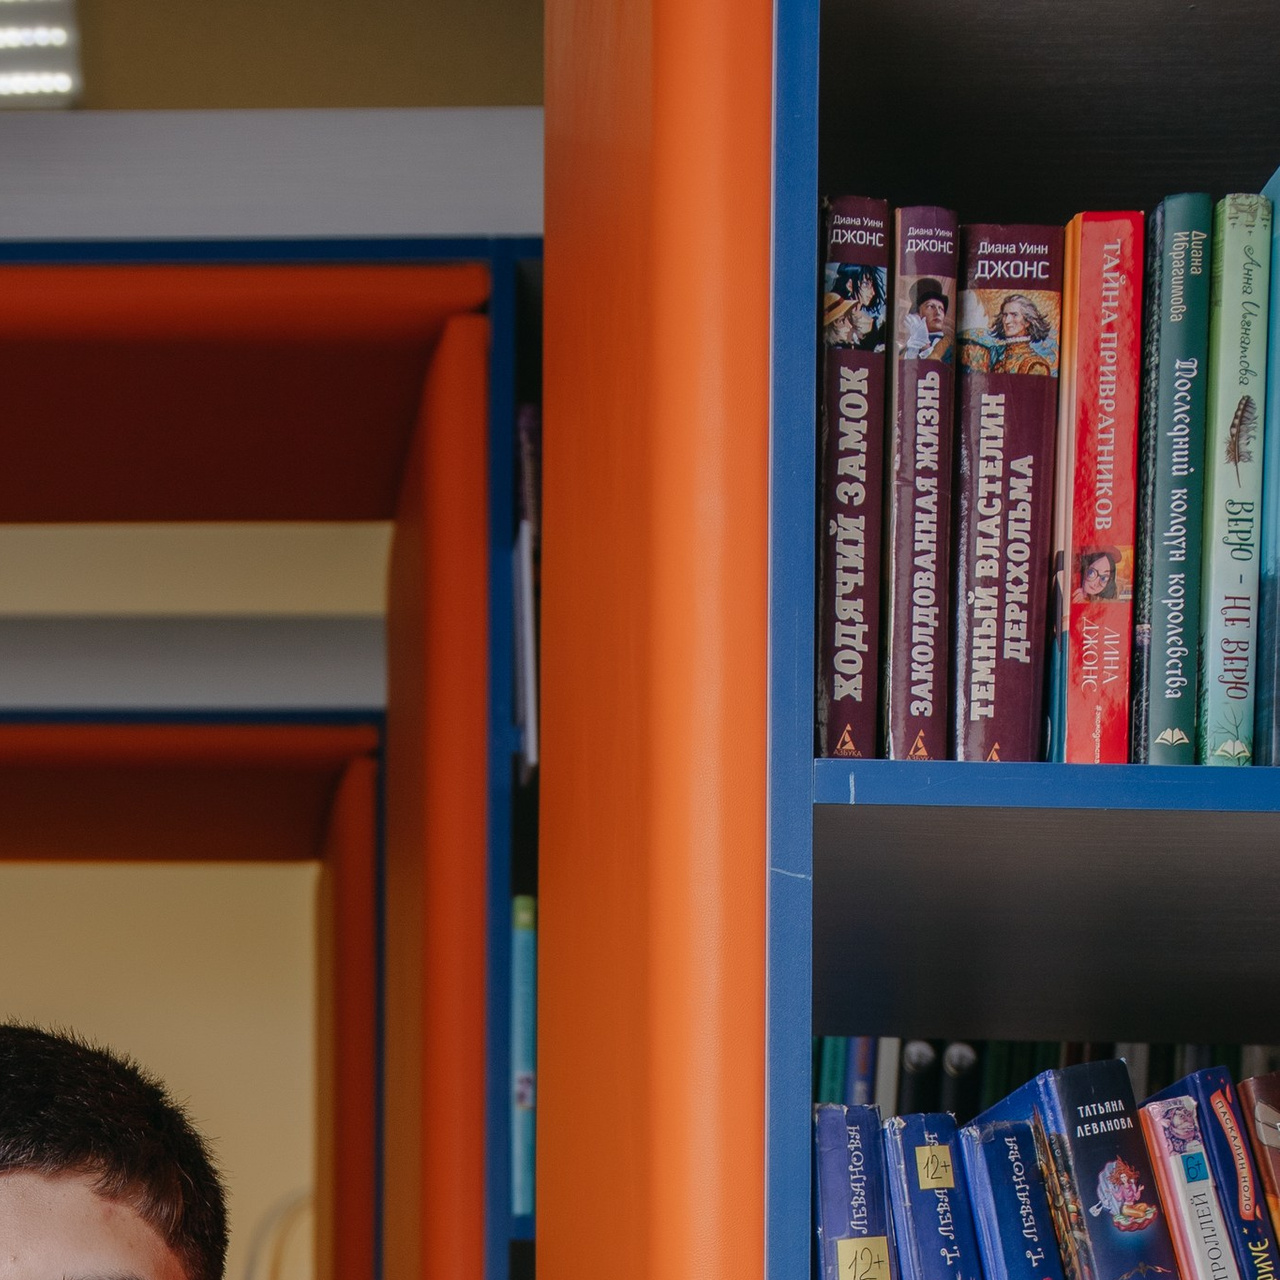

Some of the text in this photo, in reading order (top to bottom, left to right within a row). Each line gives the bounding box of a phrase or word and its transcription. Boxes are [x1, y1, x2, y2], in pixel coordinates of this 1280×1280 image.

[831, 229, 884, 247] ДЖОНС
[833, 215, 883, 228] Диана Уинн
[905, 239, 954, 254] ДЖОНС
[908, 227, 953, 238] Диана Уинн
[978, 241, 1048, 255] Диана Уинн
[974, 260, 1050, 280] ДЖОНС
[1169, 231, 1191, 323] Ибрагимова
[1189, 230, 1208, 275] Диана
[1238, 244, 1262, 386] Анна Игнатова
[1094, 238, 1127, 531] ТАЙНА ПРИВРАТНИКОВ
[829, 367, 870, 702] ХОДЯЧИЙ ЗАМОК
[910, 371, 941, 717] ЗАКОЛДОВАННАЯ ЖИЗНЬ
[967, 393, 1006, 721] ТЕМНЫЙ ВЛАСТЕЛИН
[1160, 357, 1199, 699] Последний колдун королевства
[1222, 499, 1256, 562] ВЕРЮ
[1003, 455, 1034, 663] ДЕРКХОЛЬМА
[1220, 594, 1252, 629] НЕ
[1080, 616, 1099, 693] ДЖОНС
[1101, 626, 1121, 685] ЛИНА
[1217, 637, 1250, 700] ВЕРЮ
[833, 748, 863, 758] АЗБУКА
[1092, 705, 1103, 764] #эксмодетств
[1076, 1116, 1134, 1138] ЛЕВАНОВА
[1077, 1099, 1125, 1119] ТАТЬЯНА
[846, 1124, 868, 1235] ЛЕВАНОВА
[923, 1154, 951, 1180] 12+
[1185, 1156, 1203, 1180] 6+
[1215, 1100, 1252, 1212] ПАСКАЛИН НОЛО
[1004, 1136, 1039, 1242] ЛЕВАНОВА
